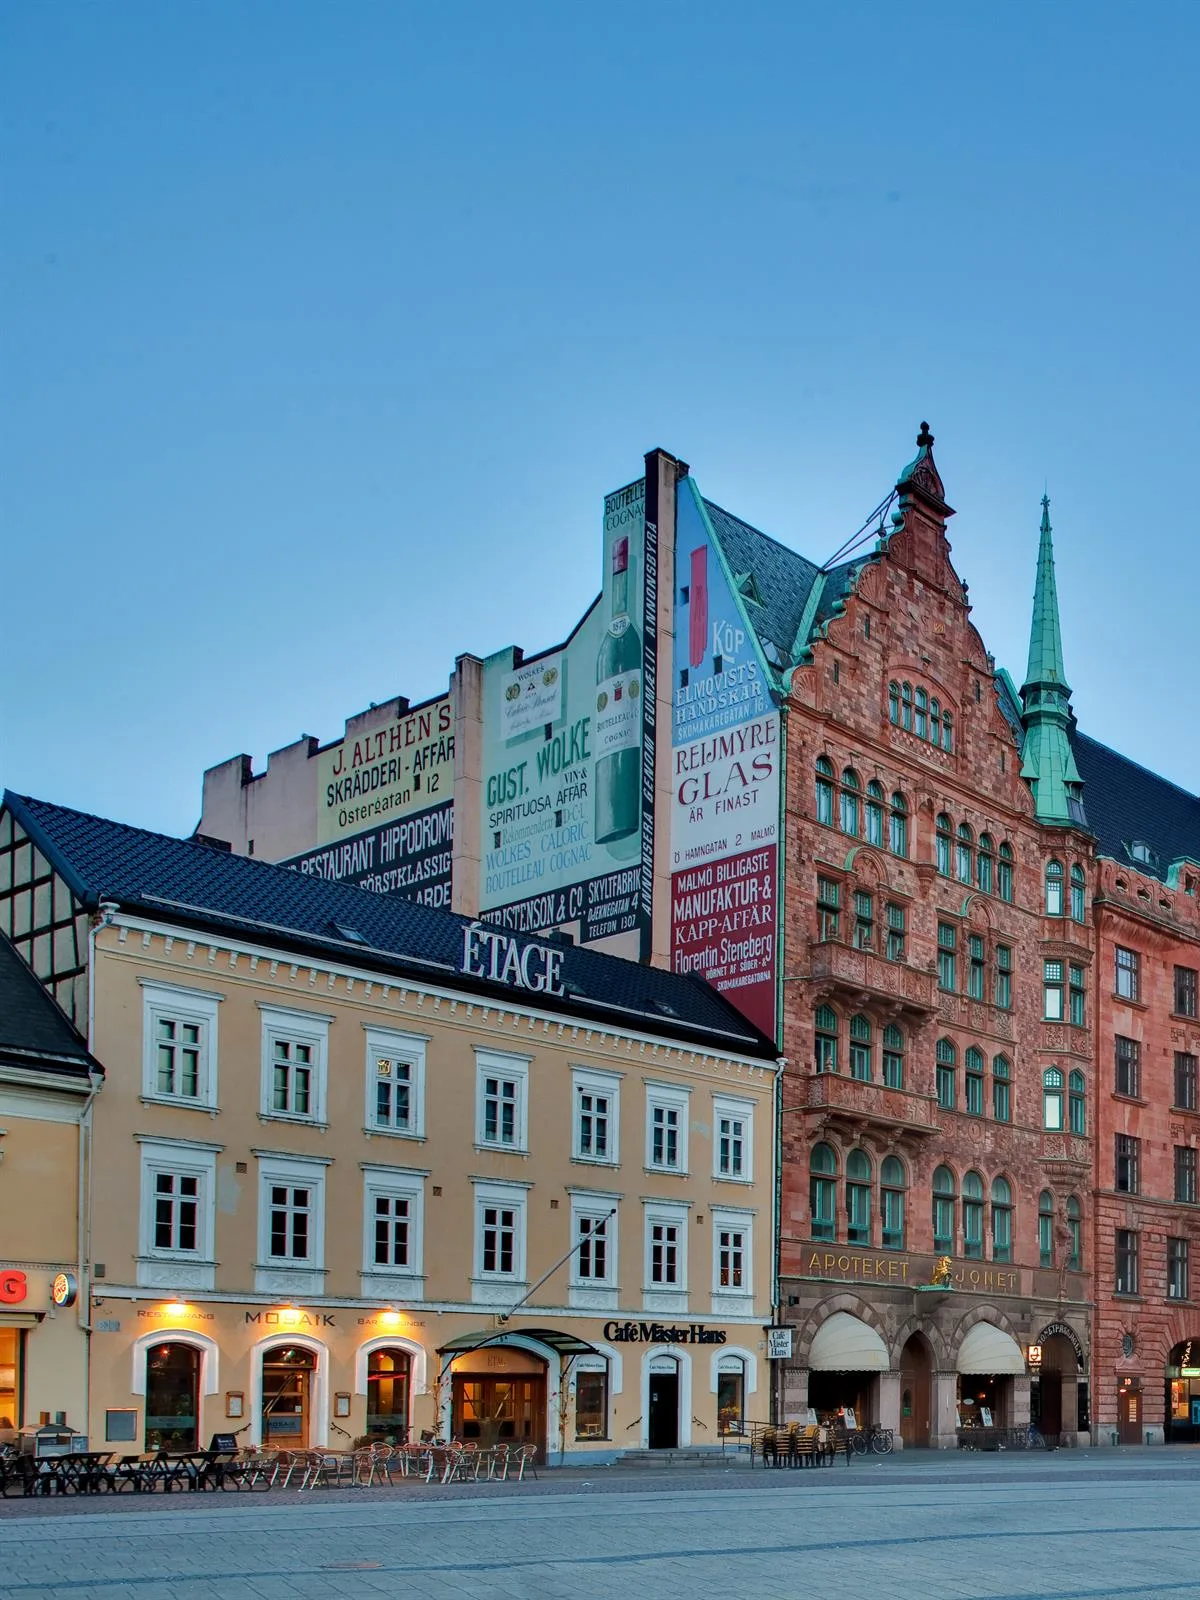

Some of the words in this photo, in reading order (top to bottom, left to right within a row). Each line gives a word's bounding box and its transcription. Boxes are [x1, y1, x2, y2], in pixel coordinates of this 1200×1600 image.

[712, 619, 746, 664] KÖP
[333, 749, 347, 776] J.
[351, 703, 451, 769] ALTHÉN'S
[678, 703, 751, 740] SKOMAKAREGATAN
[487, 760, 529, 808] GUST.
[536, 716, 592, 784] WOLKE
[643, 733, 656, 804] GENOM
[675, 718, 777, 776] REIJMYRE
[326, 756, 401, 808] SKRÄDDERI
[412, 735, 455, 774] AFFÄR
[678, 751, 773, 807] GLAS
[338, 798, 411, 827] Östergatan
[427, 773, 440, 794] 12
[488, 794, 552, 829] SPIRITUOSA
[556, 782, 588, 807] AFFÄR
[688, 805, 704, 824] ÄR
[715, 789, 760, 816] FINAST
[301, 834, 376, 882] RESTAURANT
[486, 839, 532, 872] WOLKES
[540, 820, 590, 853] CALORIC
[684, 838, 728, 862] HAMNGATAN
[735, 833, 743, 847] 2
[750, 824, 775, 842] MALMÖ
[485, 858, 546, 895] BOUTELLEAU
[549, 842, 593, 873] COGNAC
[588, 867, 642, 904] SKYLTFABRIK
[641, 813, 654, 918] ANNONSERA
[677, 866, 713, 894] MALMÖ
[716, 851, 769, 883] BILLIGASTE
[556, 894, 566, 922] &
[631, 892, 639, 911] 4
[588, 919, 617, 939] TELEFON
[620, 914, 636, 930] 1307
[674, 903, 773, 946] KAPP-AFFÄR
[460, 921, 565, 997] ÉTAGE
[674, 945, 718, 976] Florentin
[720, 932, 773, 966] Steneberg
[729, 963, 737, 974] AF
[808, 1252, 909, 1283] APOTEKET
[244, 1310, 336, 1327] MOSAIK
[603, 1321, 639, 1342] Café
[639, 1322, 689, 1343] Mäster
[689, 1324, 727, 1344] Hans
[772, 1331, 785, 1340] Café
[771, 1347, 787, 1357] Hans
